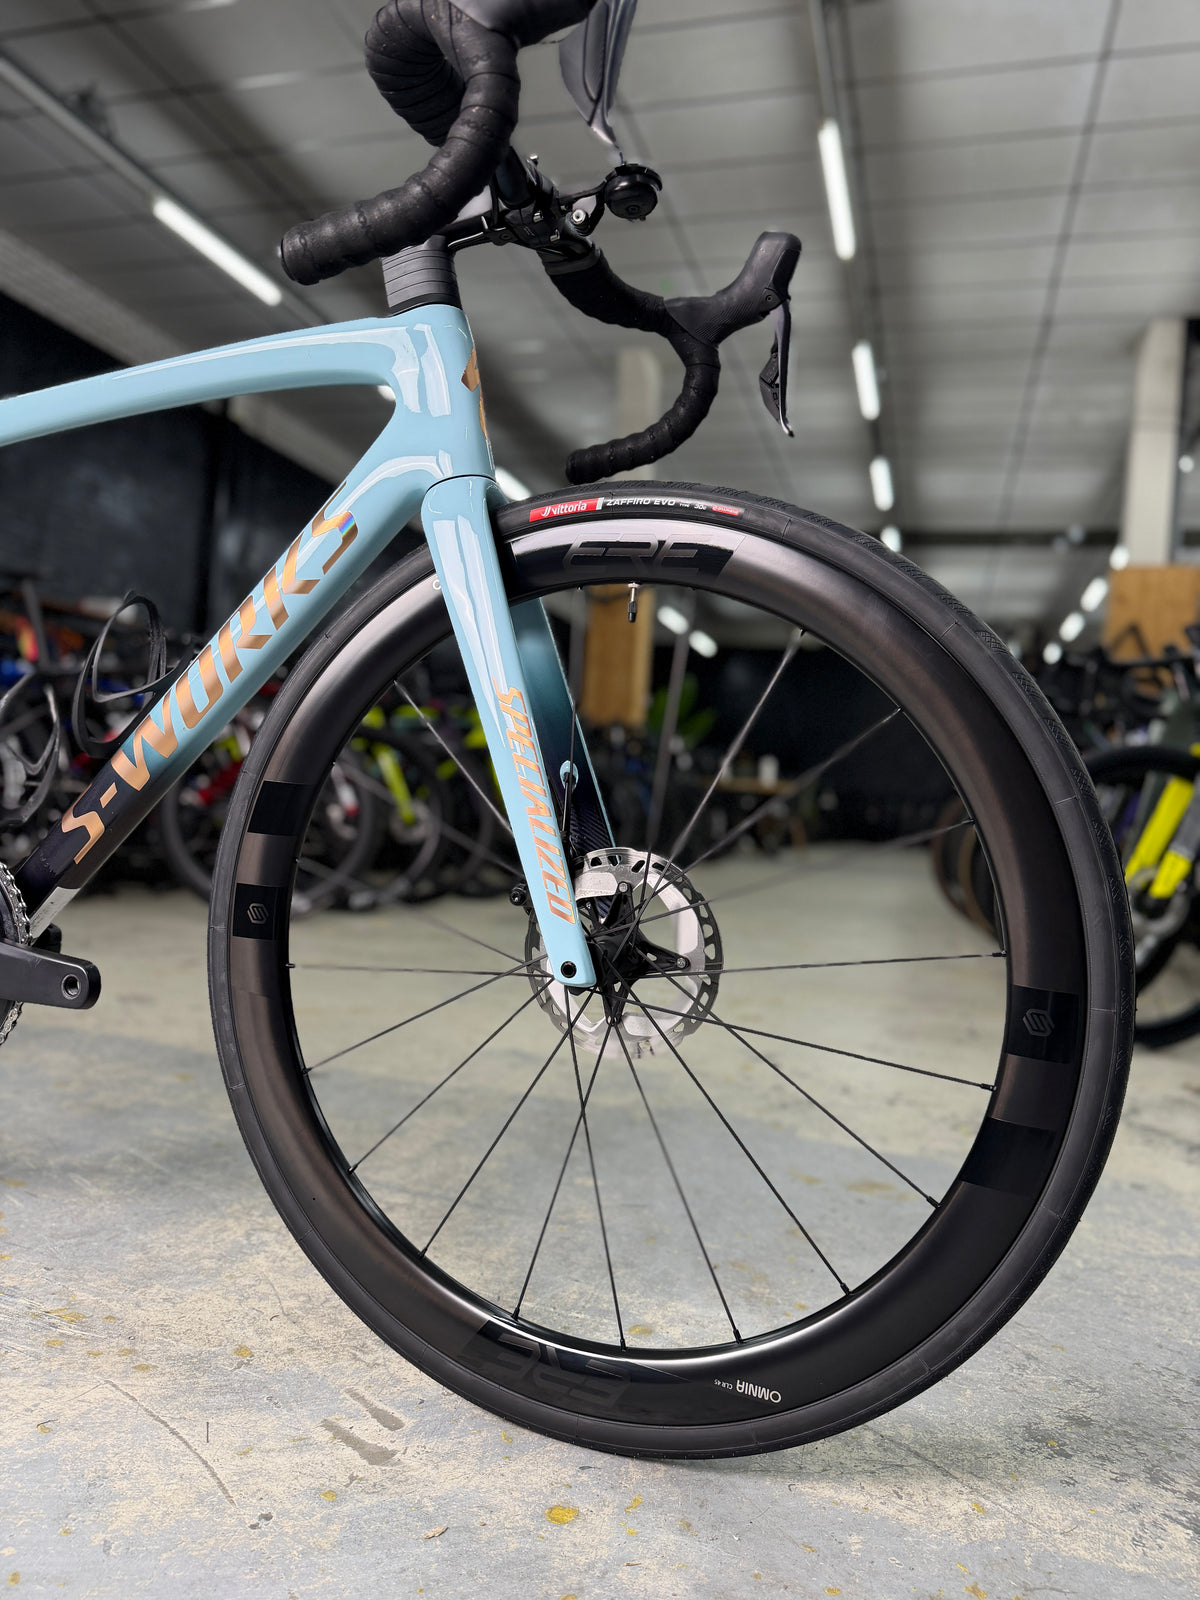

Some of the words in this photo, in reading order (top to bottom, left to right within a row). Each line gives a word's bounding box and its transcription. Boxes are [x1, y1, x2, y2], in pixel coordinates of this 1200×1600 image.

[551, 501, 587, 515] vittoria
[606, 498, 651, 506] ZAFFIRO
[653, 498, 676, 506] EVO
[61, 481, 359, 864] S-WORKS
[492, 677, 576, 924] SPECIALIZED
[736, 1379, 782, 1403] OMNIA
